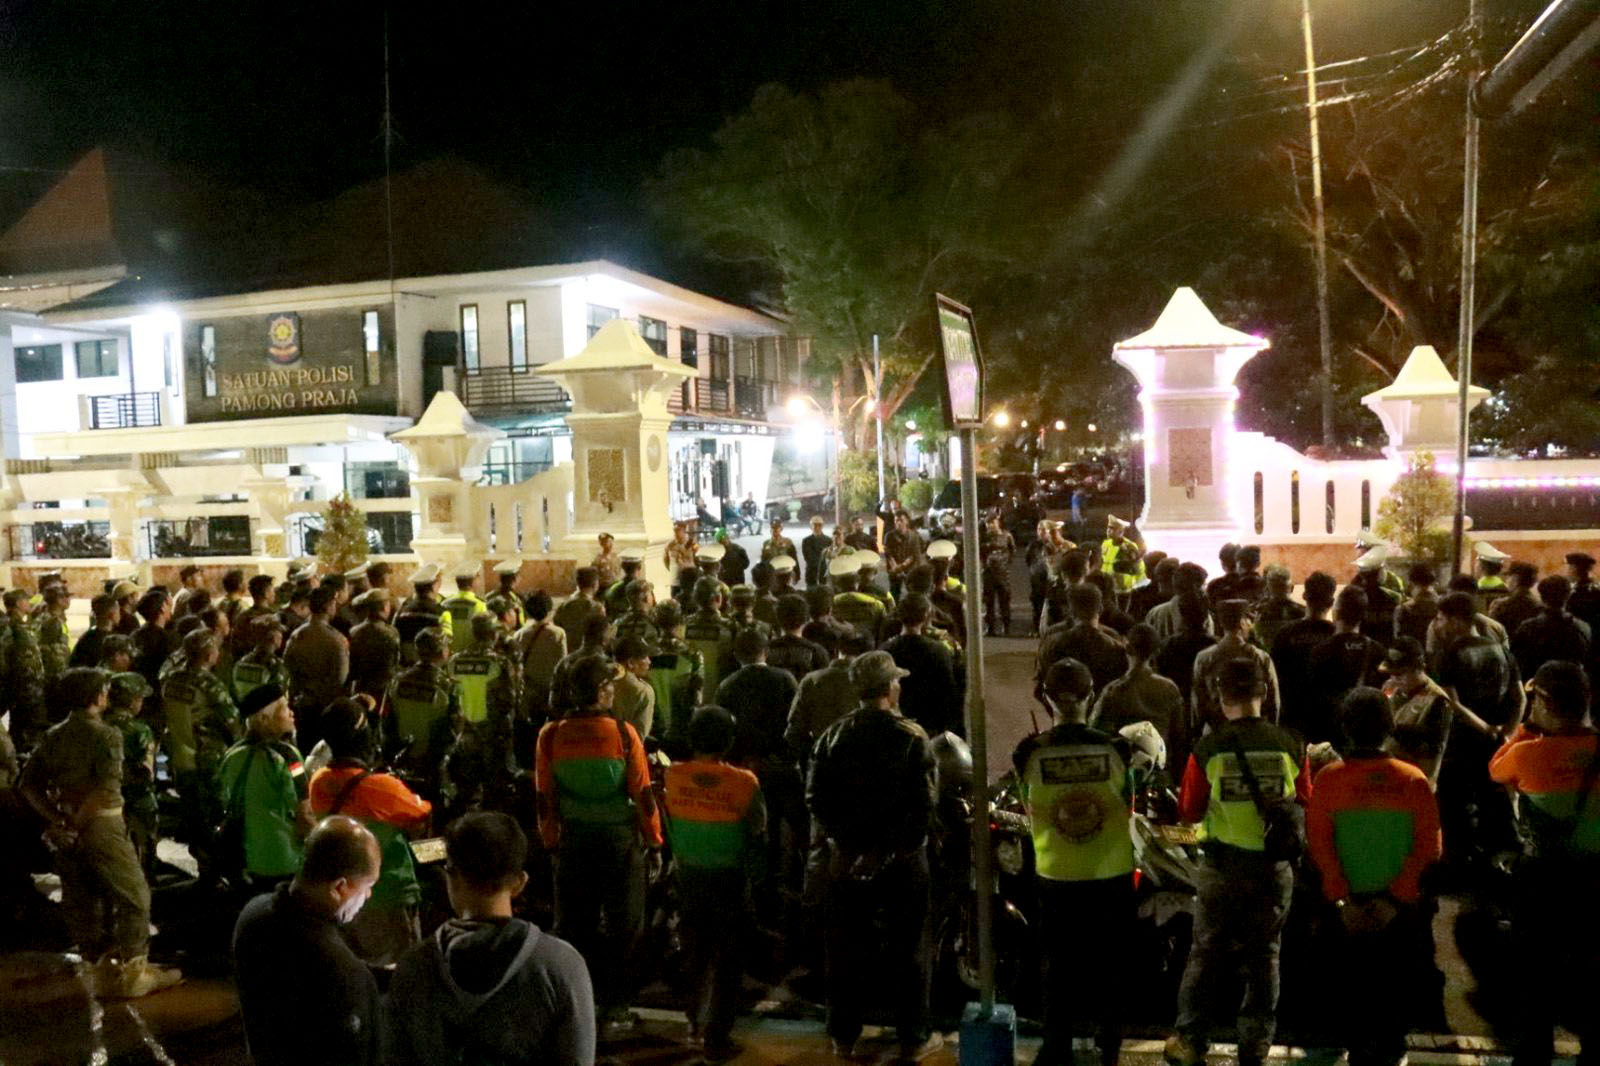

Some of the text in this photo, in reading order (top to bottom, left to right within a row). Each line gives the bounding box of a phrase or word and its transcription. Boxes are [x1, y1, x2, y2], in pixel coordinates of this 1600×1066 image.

[222, 365, 354, 390] SATUAN POLISI
[221, 389, 358, 412] PAMONG PRAJA
